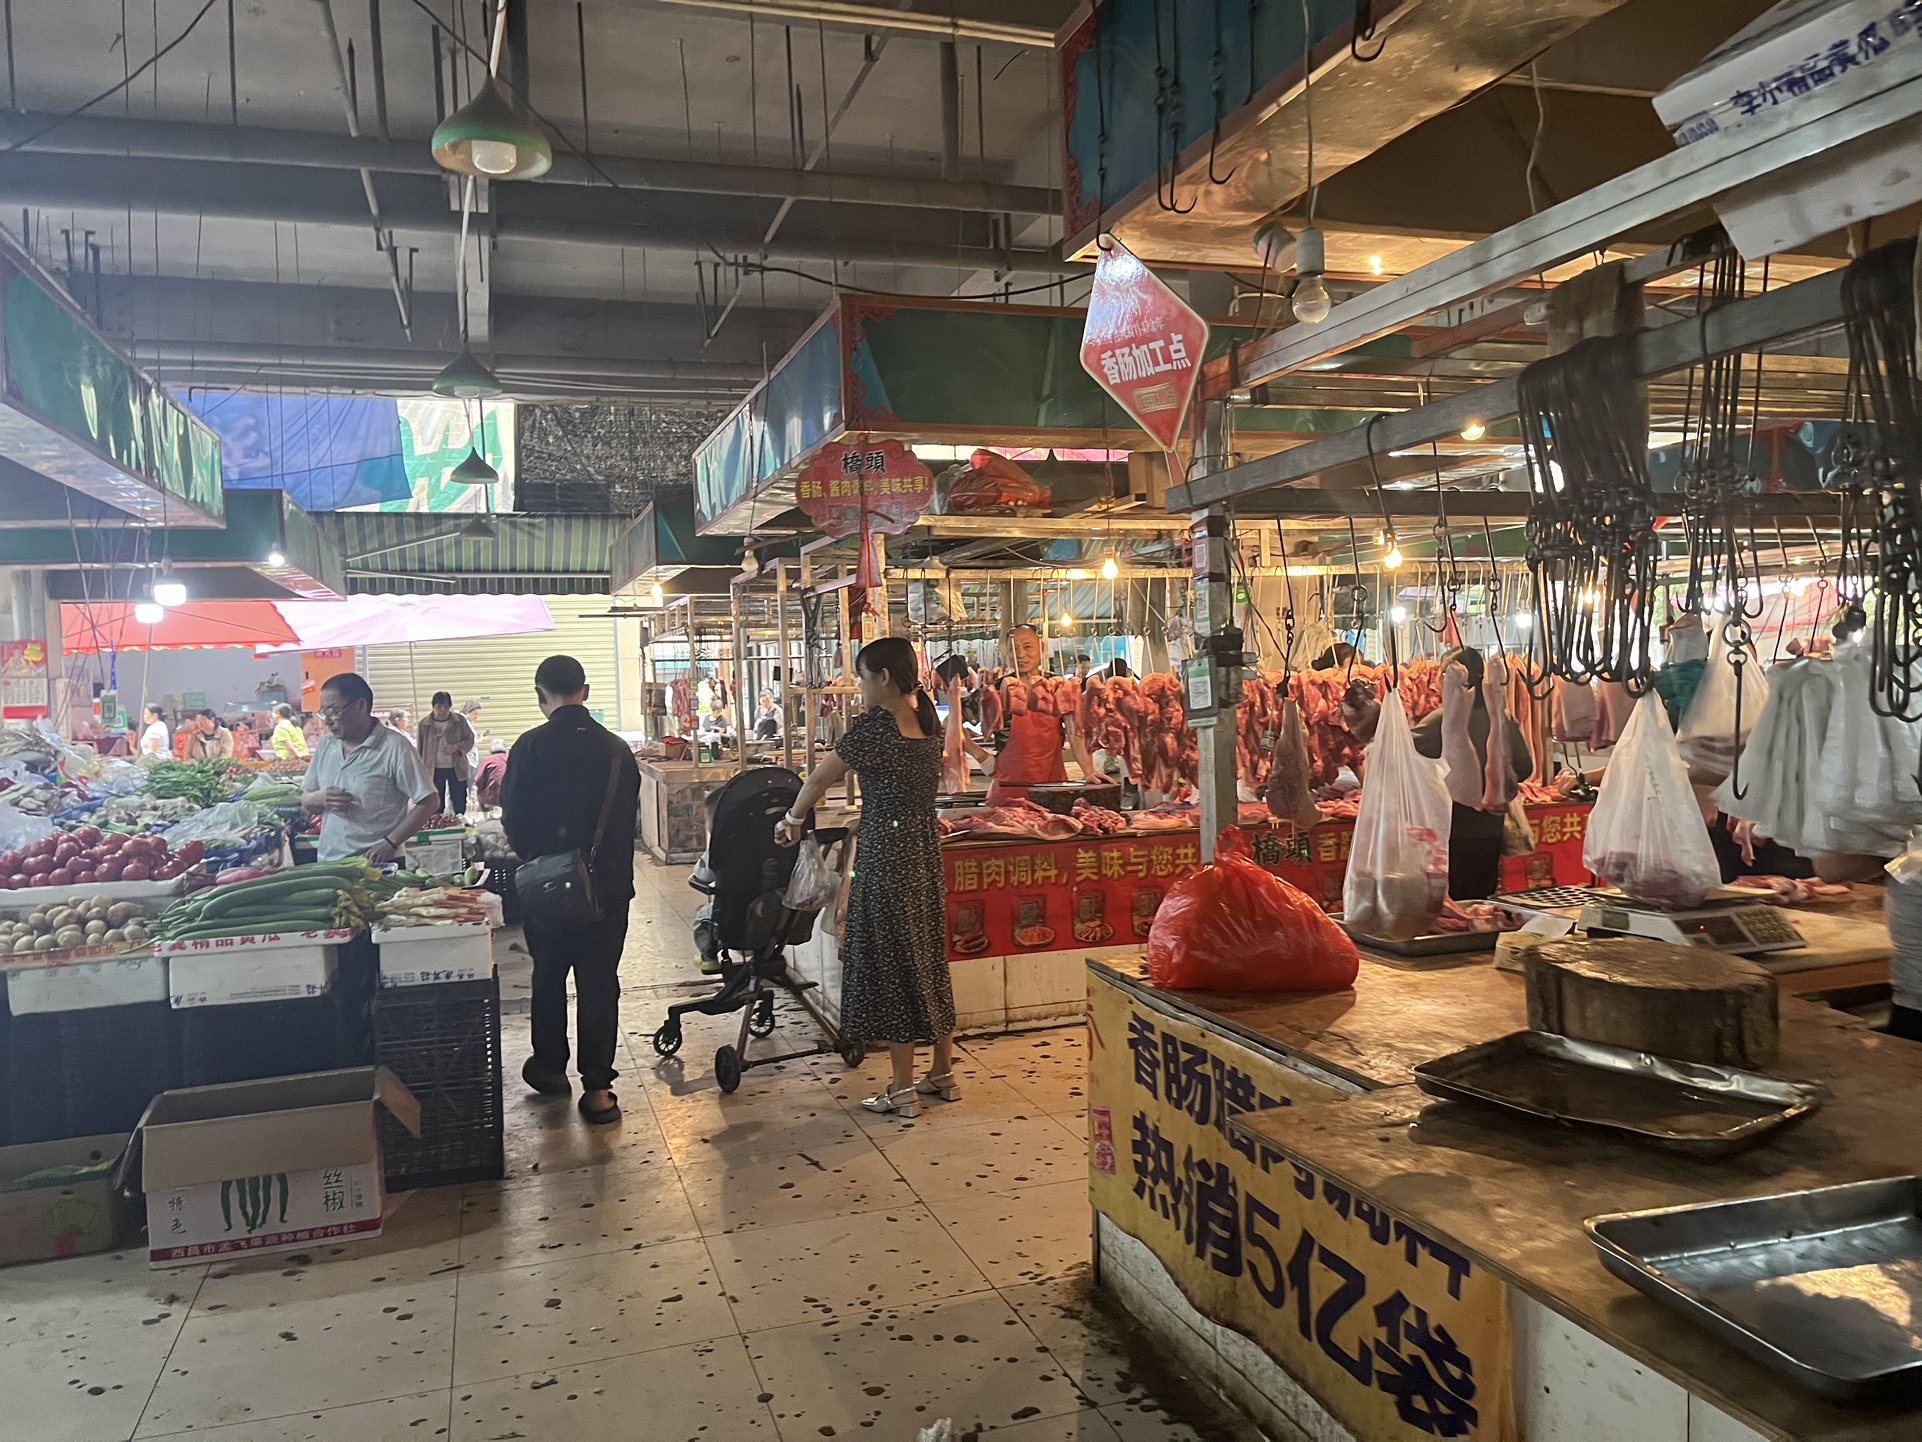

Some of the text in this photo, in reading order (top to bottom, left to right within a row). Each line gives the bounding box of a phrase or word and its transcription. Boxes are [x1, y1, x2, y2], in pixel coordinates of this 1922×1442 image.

[1100, 332, 1192, 386] 香肠加工点
[841, 450, 887, 476] 橋頭
[1250, 830, 1313, 867] 橋頭
[322, 1168, 345, 1212] 丝椒
[167, 1194, 187, 1235] 特色
